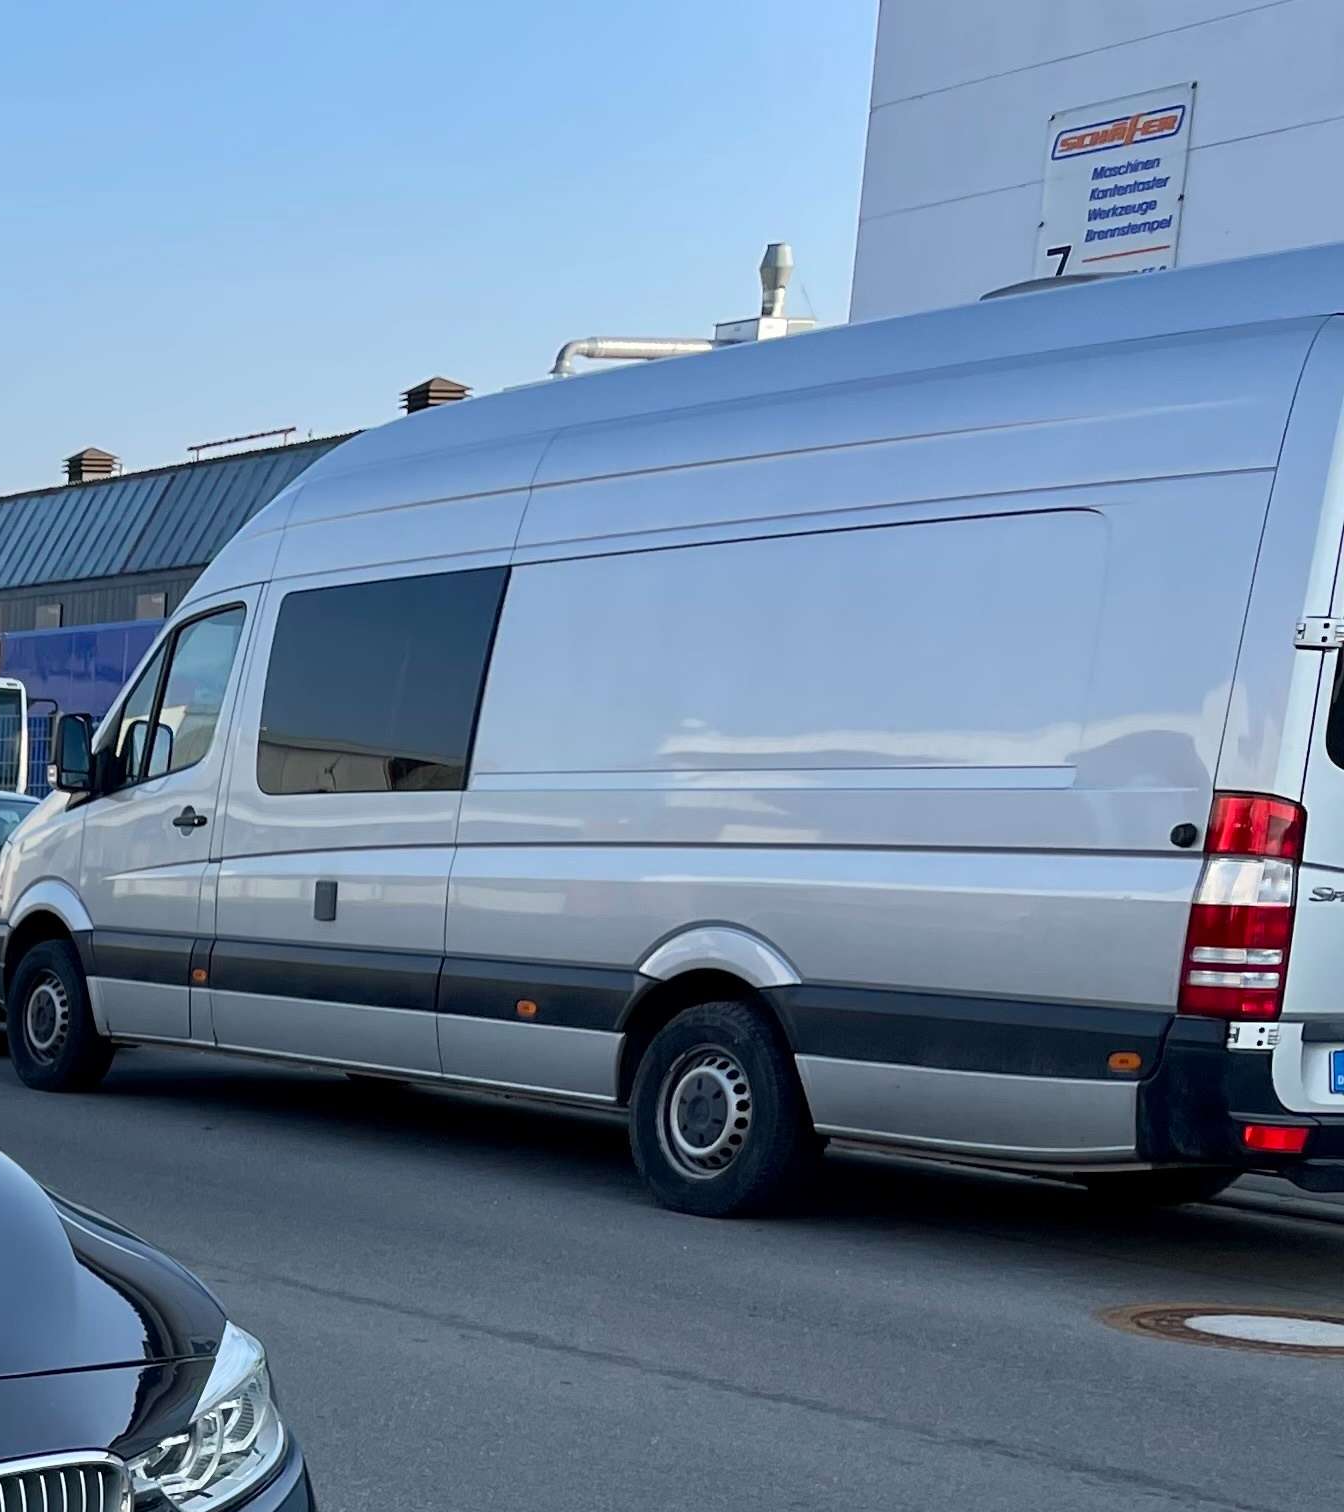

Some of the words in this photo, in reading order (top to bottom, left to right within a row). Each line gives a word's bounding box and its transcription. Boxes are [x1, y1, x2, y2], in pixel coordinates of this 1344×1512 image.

[1091, 158, 1161, 181] Maschinen
[1089, 176, 1171, 201] Kantentaster
[1087, 200, 1158, 222] Werkzeuge
[1084, 215, 1173, 243] Brennstempel
[1046, 245, 1072, 277] 7
